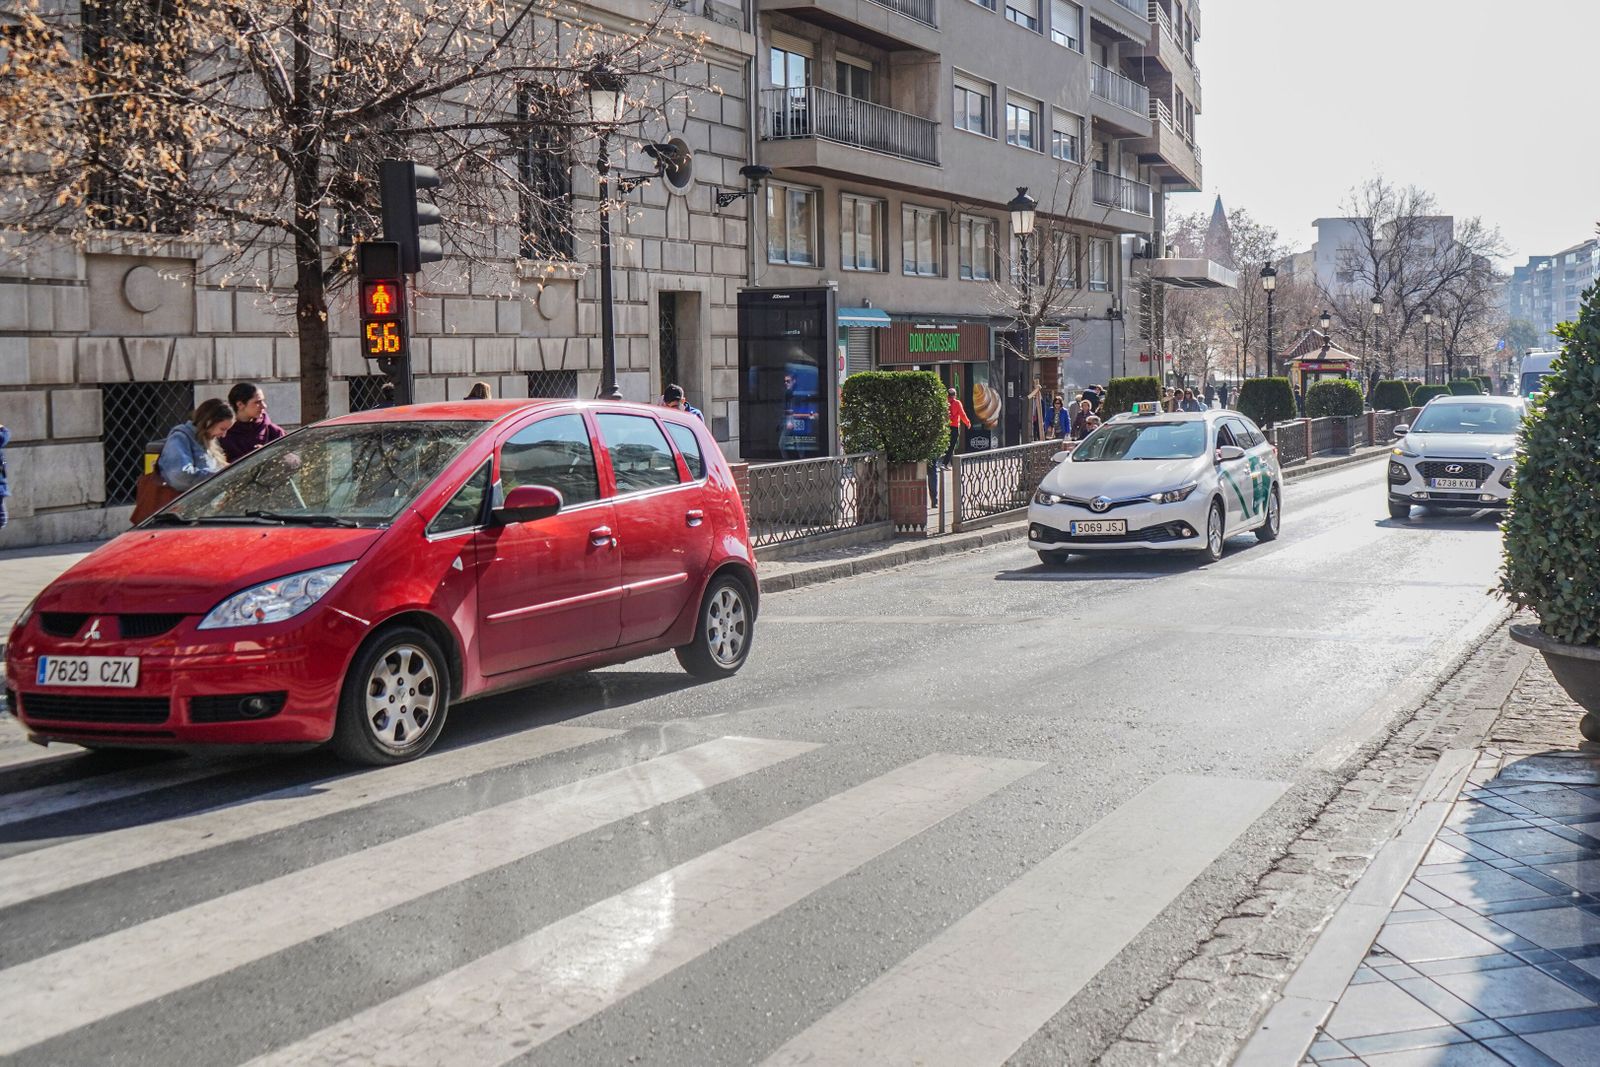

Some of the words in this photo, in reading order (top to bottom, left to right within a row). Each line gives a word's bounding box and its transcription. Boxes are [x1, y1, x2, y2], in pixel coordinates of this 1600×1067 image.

[366, 322, 400, 353] 56
[909, 332, 924, 352] DON
[925, 332, 960, 352] CROISSANT
[1436, 479, 1457, 488] 4738
[1459, 479, 1475, 488] KXX
[1077, 522, 1102, 533] 5069
[1105, 522, 1124, 532] JSJ
[47, 659, 89, 682] 7629
[99, 661, 133, 683] CZK
